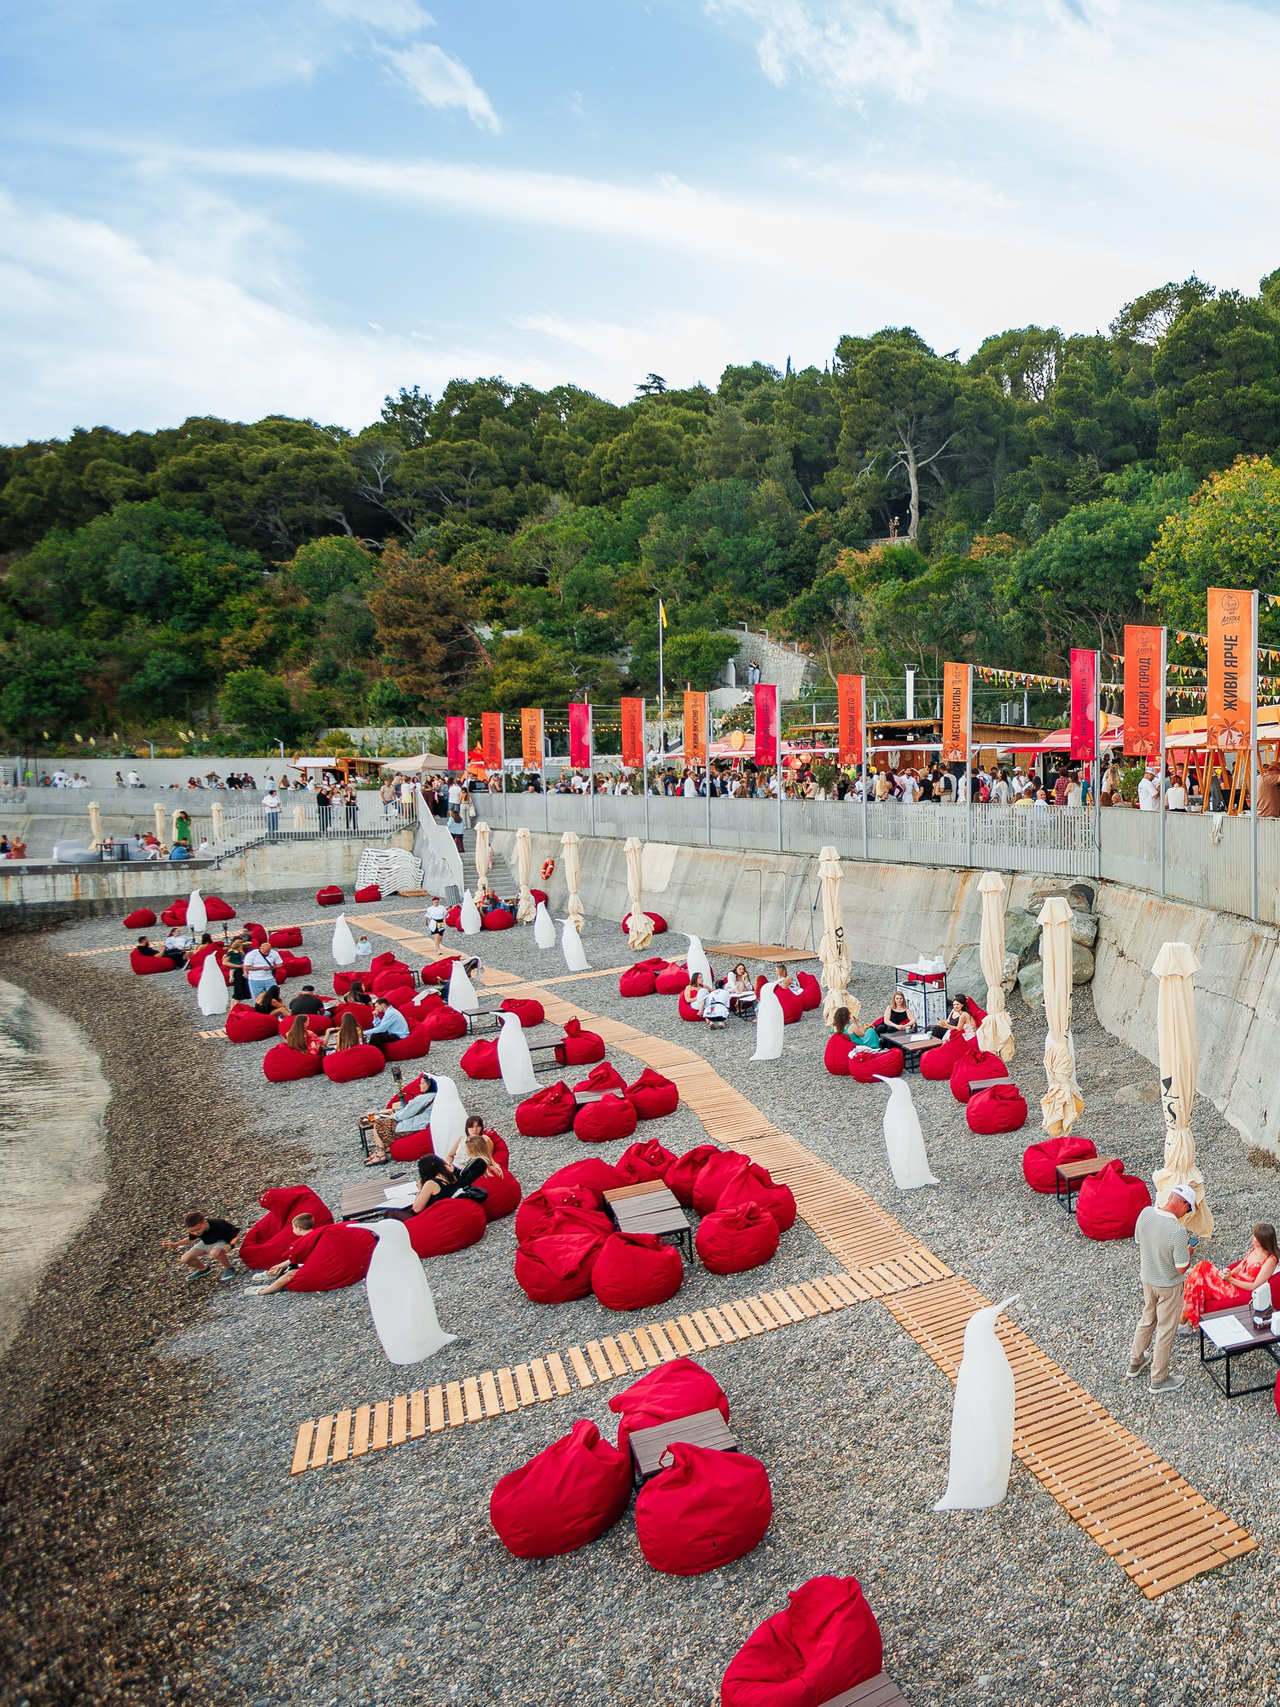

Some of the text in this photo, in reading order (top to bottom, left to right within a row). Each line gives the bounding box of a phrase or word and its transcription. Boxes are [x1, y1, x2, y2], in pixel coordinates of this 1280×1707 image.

[1138, 657, 1151, 689] ГОРОД
[1222, 634, 1238, 712] ЖИВИ ЯРЧЕ
[762, 702, 770, 725] ВЕЧЕР
[848, 697, 856, 714] ЛЕТО
[952, 687, 962, 712] СИЛЫ
[1137, 690, 1151, 728] ОТКРОЙ
[528, 724, 537, 757] БЕЗ ГРАНИЦ
[847, 715, 856, 746] ВКЛЮЧАЙ
[951, 713, 961, 742] МЕСТО
